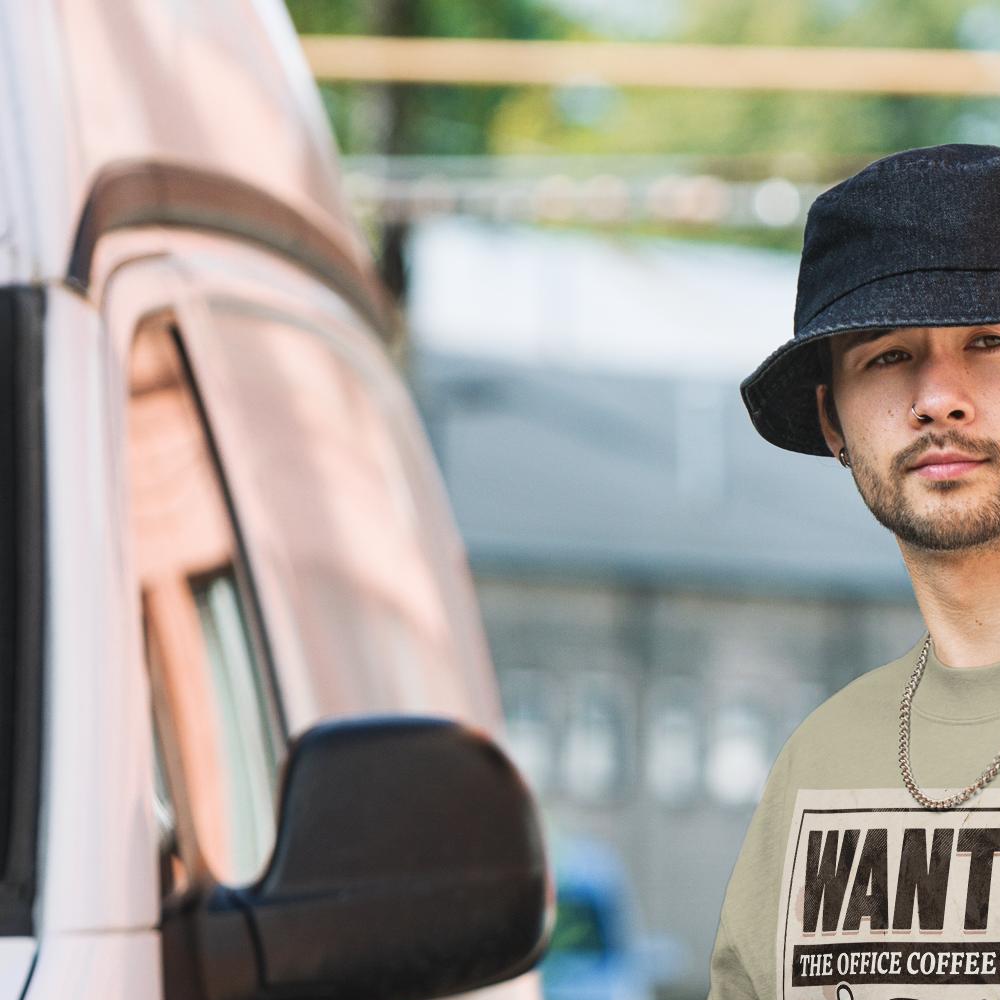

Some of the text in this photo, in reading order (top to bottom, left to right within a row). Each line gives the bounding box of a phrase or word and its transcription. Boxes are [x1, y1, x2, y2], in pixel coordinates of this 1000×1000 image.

[799, 952, 833, 977] THE
[836, 951, 901, 976] OFFICE
[906, 951, 996, 975] COFFEE
